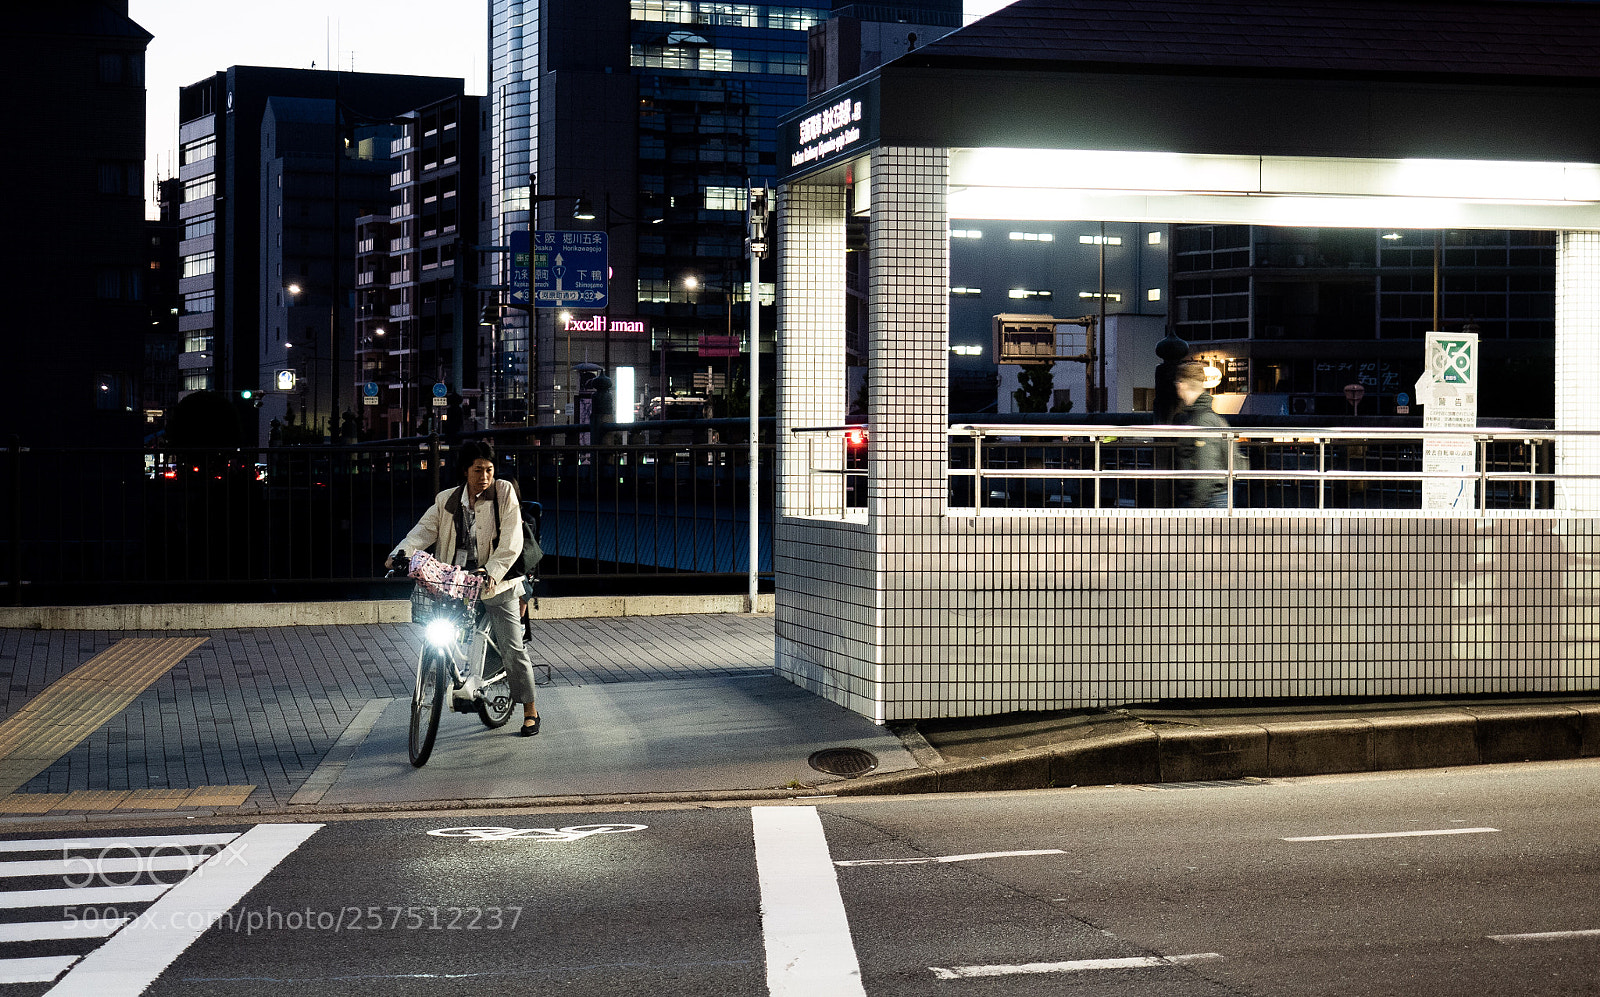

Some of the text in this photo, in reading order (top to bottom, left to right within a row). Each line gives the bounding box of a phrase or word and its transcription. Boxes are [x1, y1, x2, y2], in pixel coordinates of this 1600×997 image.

[563, 233, 602, 244] 堀川五条
[514, 269, 549, 280] 九条原町
[584, 291, 594, 299] 32
